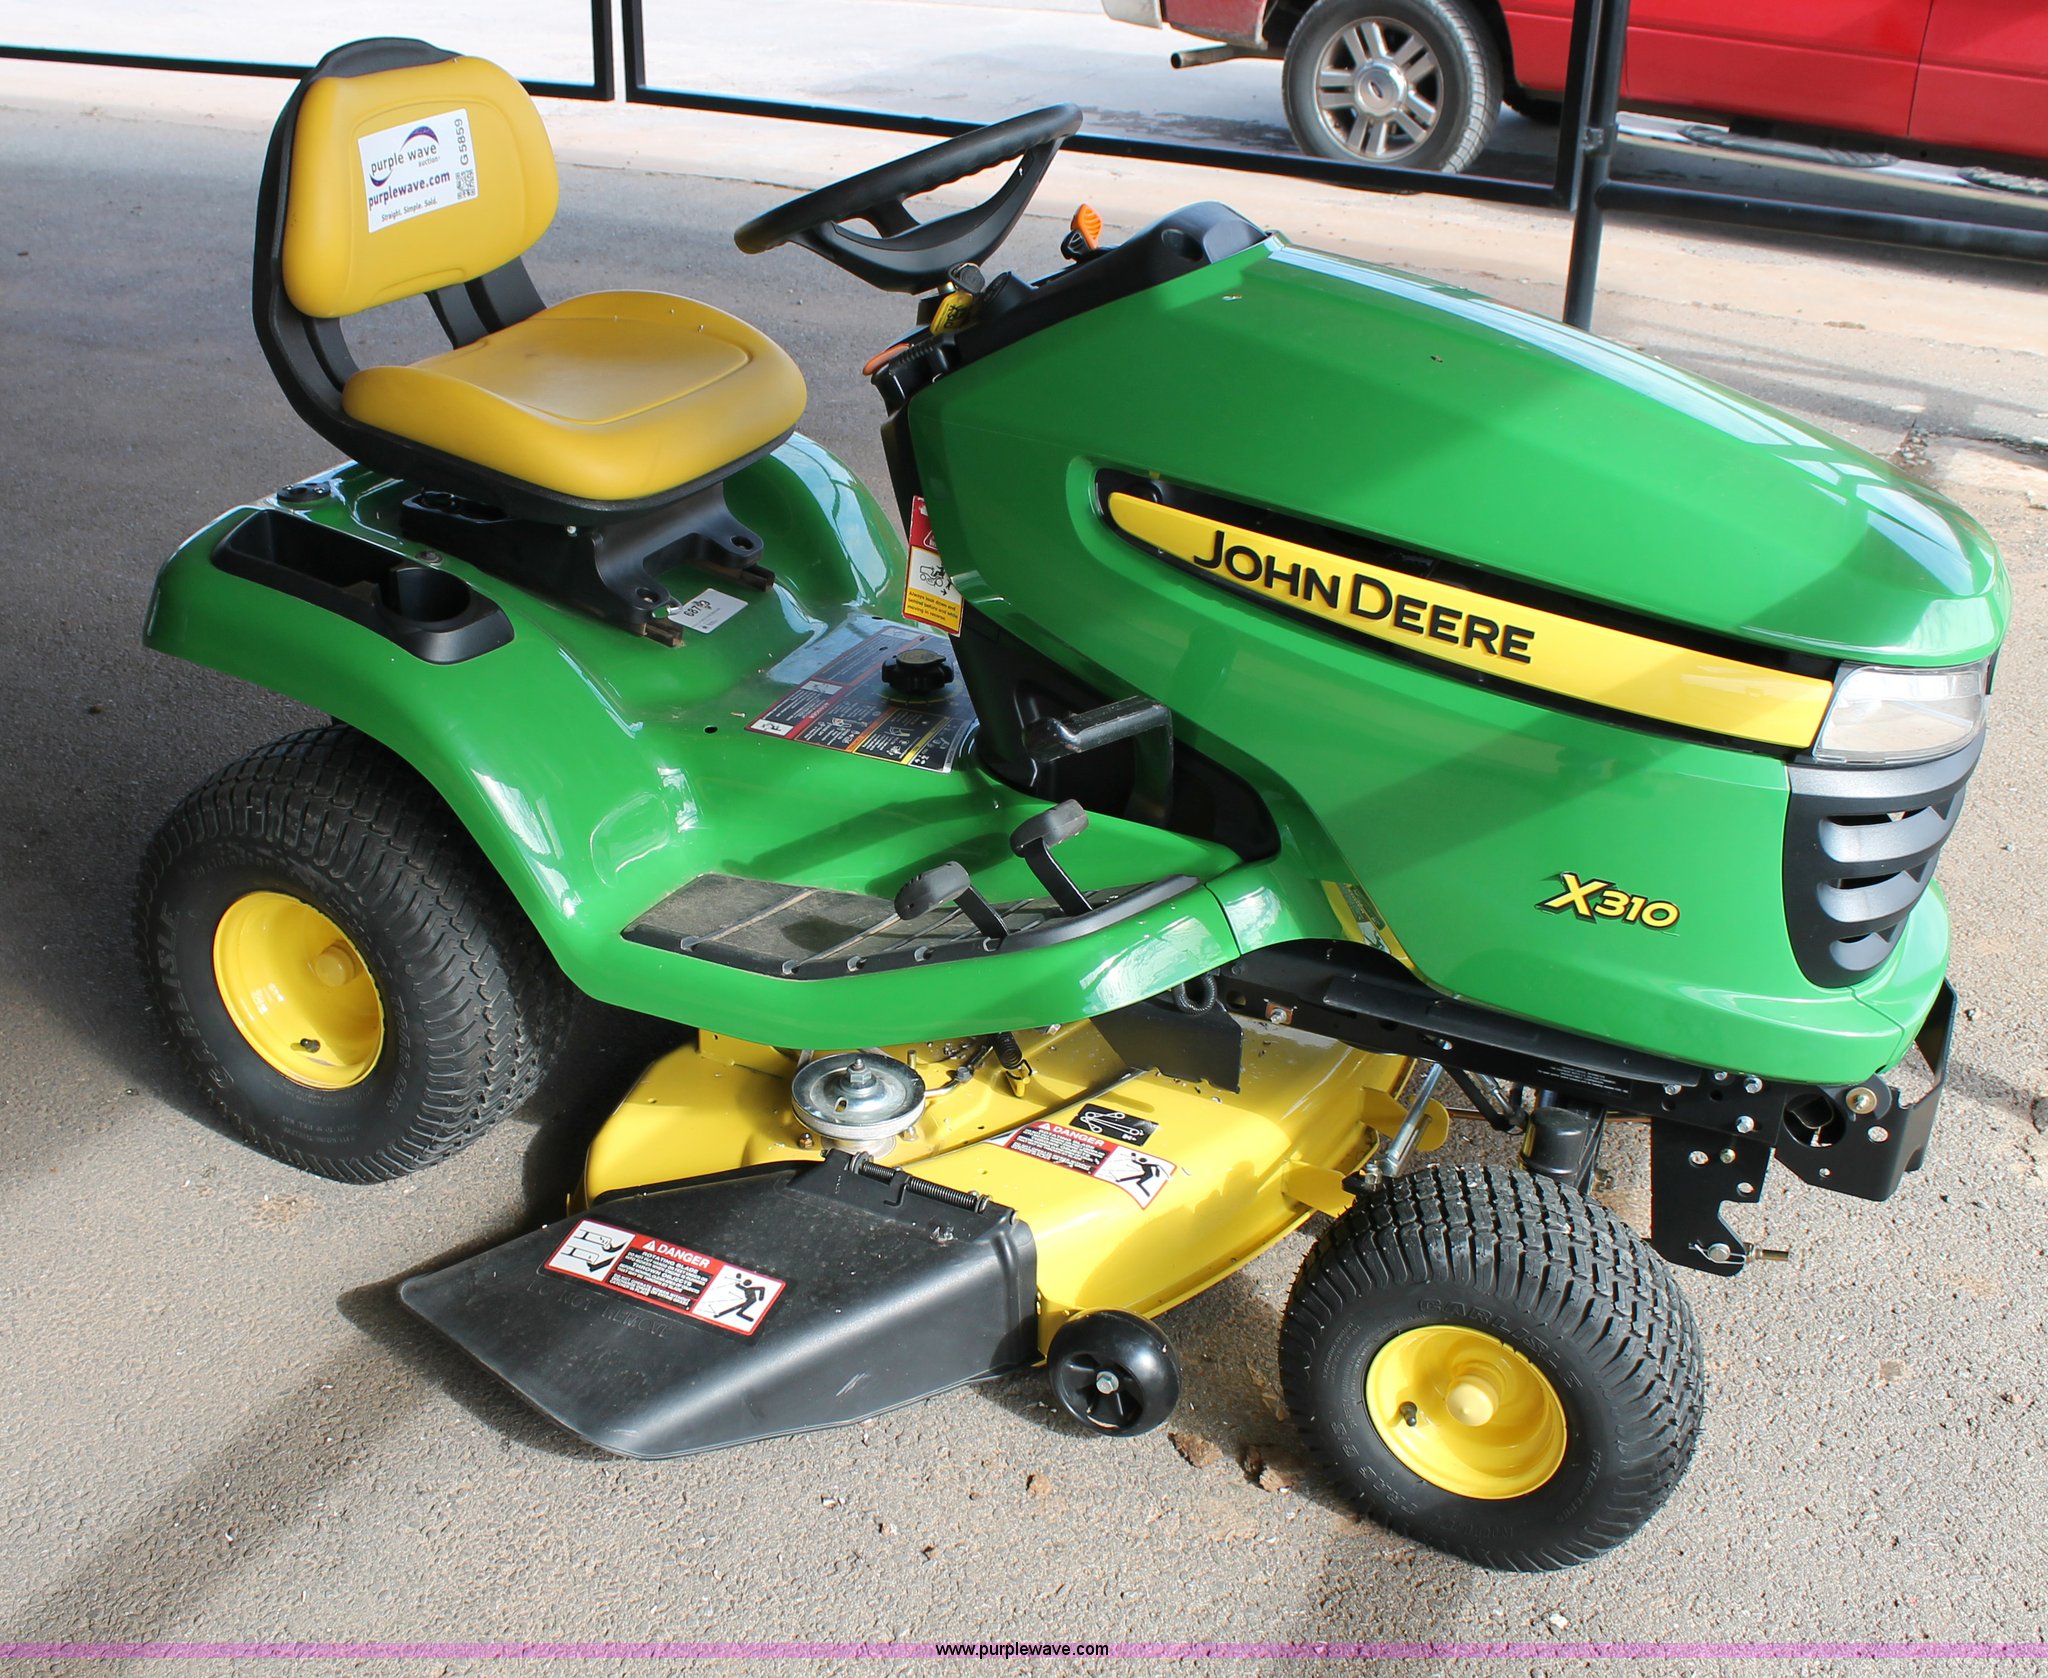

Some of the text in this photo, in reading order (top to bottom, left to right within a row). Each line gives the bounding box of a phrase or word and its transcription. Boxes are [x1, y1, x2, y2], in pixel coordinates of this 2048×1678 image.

[371, 144, 437, 175] purple wave
[454, 118, 469, 166] G5859
[368, 171, 451, 211] purplewave.com
[1193, 530, 1535, 664] JOHN DEERE
[1534, 871, 1680, 929] X310
[1053, 1126, 1105, 1147] DANGER
[641, 1251, 699, 1274] ROTATING BLADE
[656, 1244, 712, 1268] DANGER
